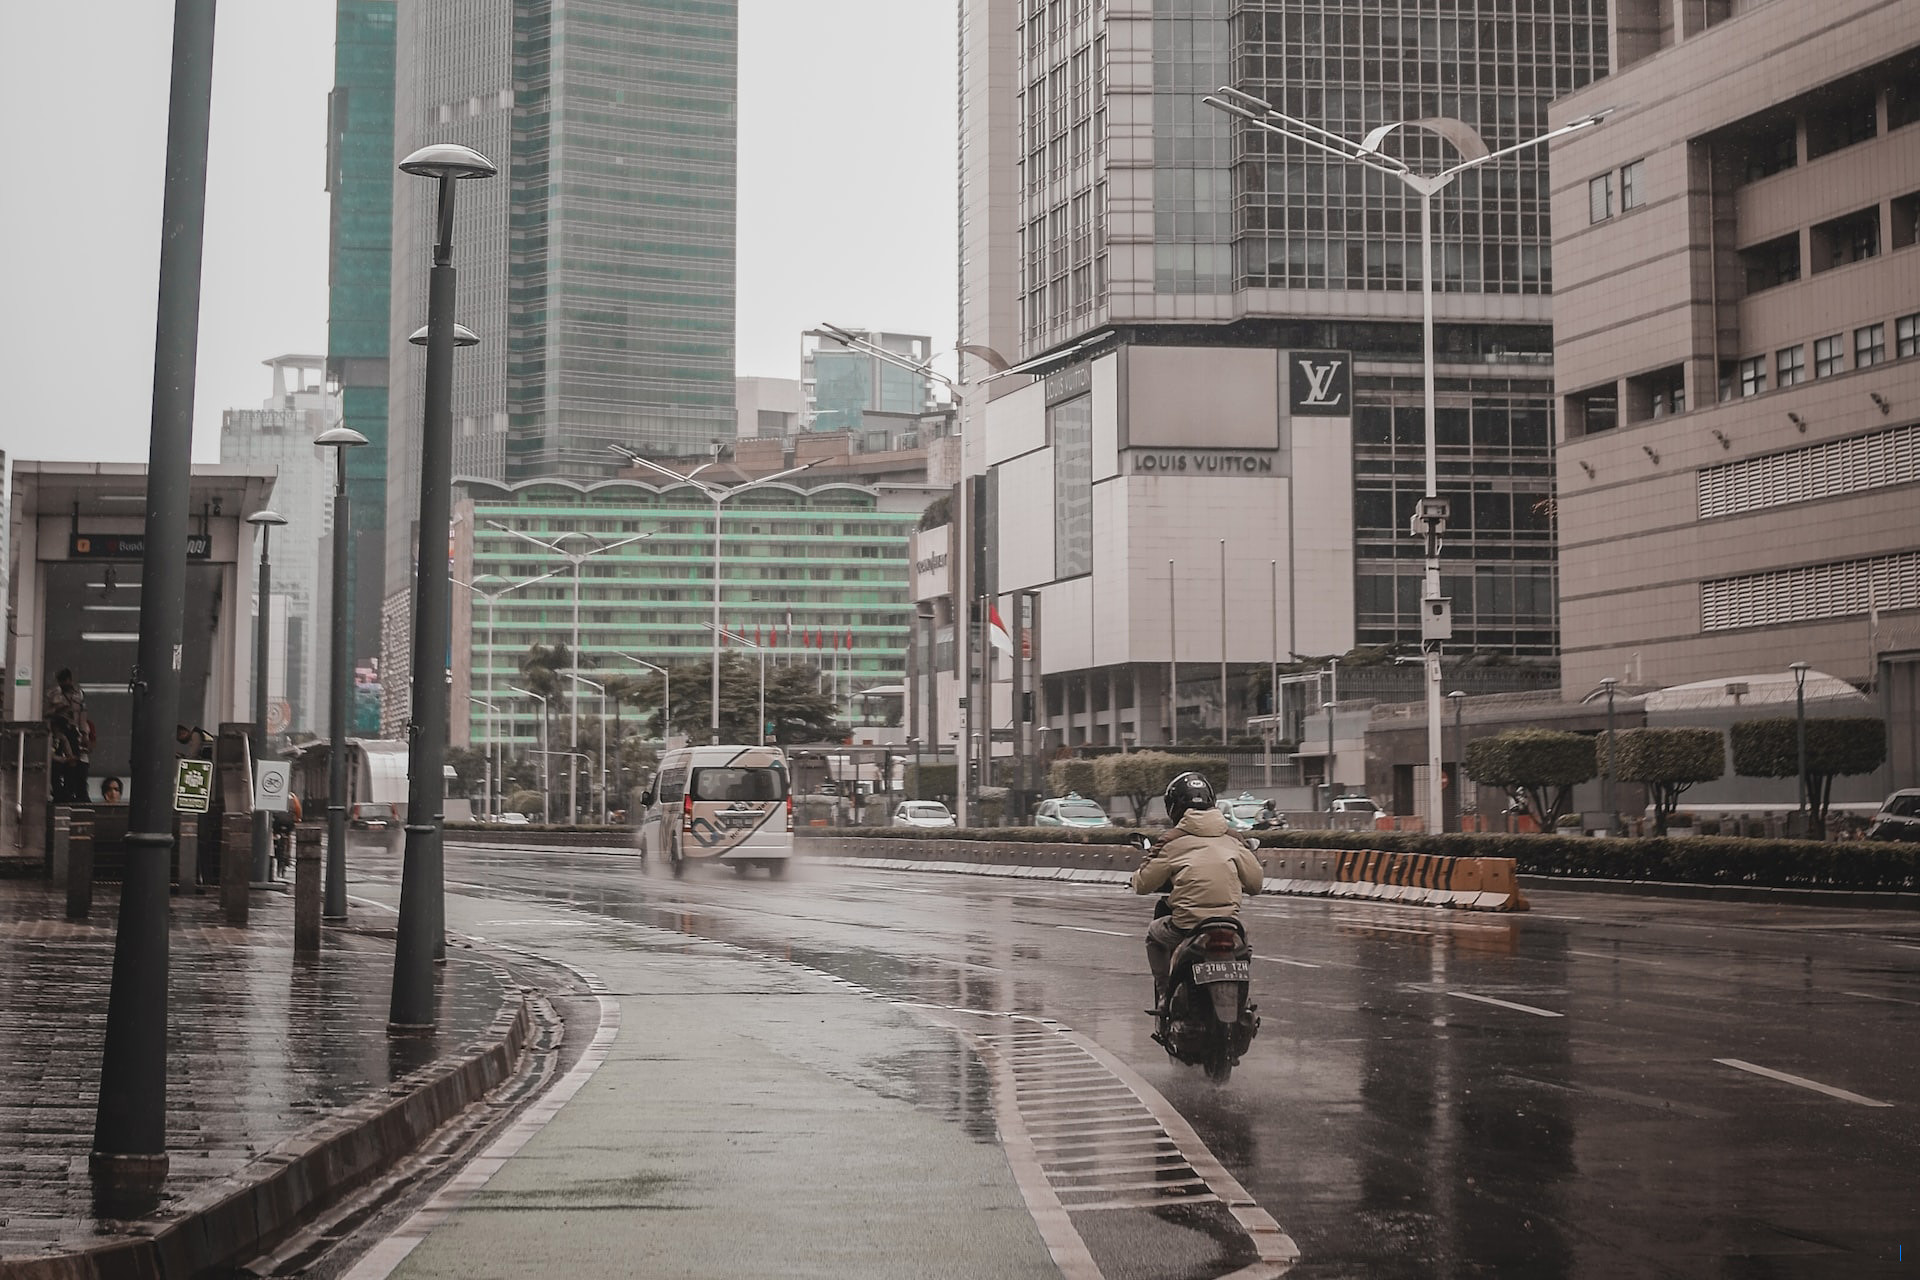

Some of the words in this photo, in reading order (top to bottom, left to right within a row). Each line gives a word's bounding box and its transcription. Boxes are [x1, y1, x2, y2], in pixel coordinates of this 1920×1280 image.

[1134, 455, 1187, 471] LOUIS
[1194, 455, 1272, 472] VUITTON
[119, 540, 145, 552] Bund
